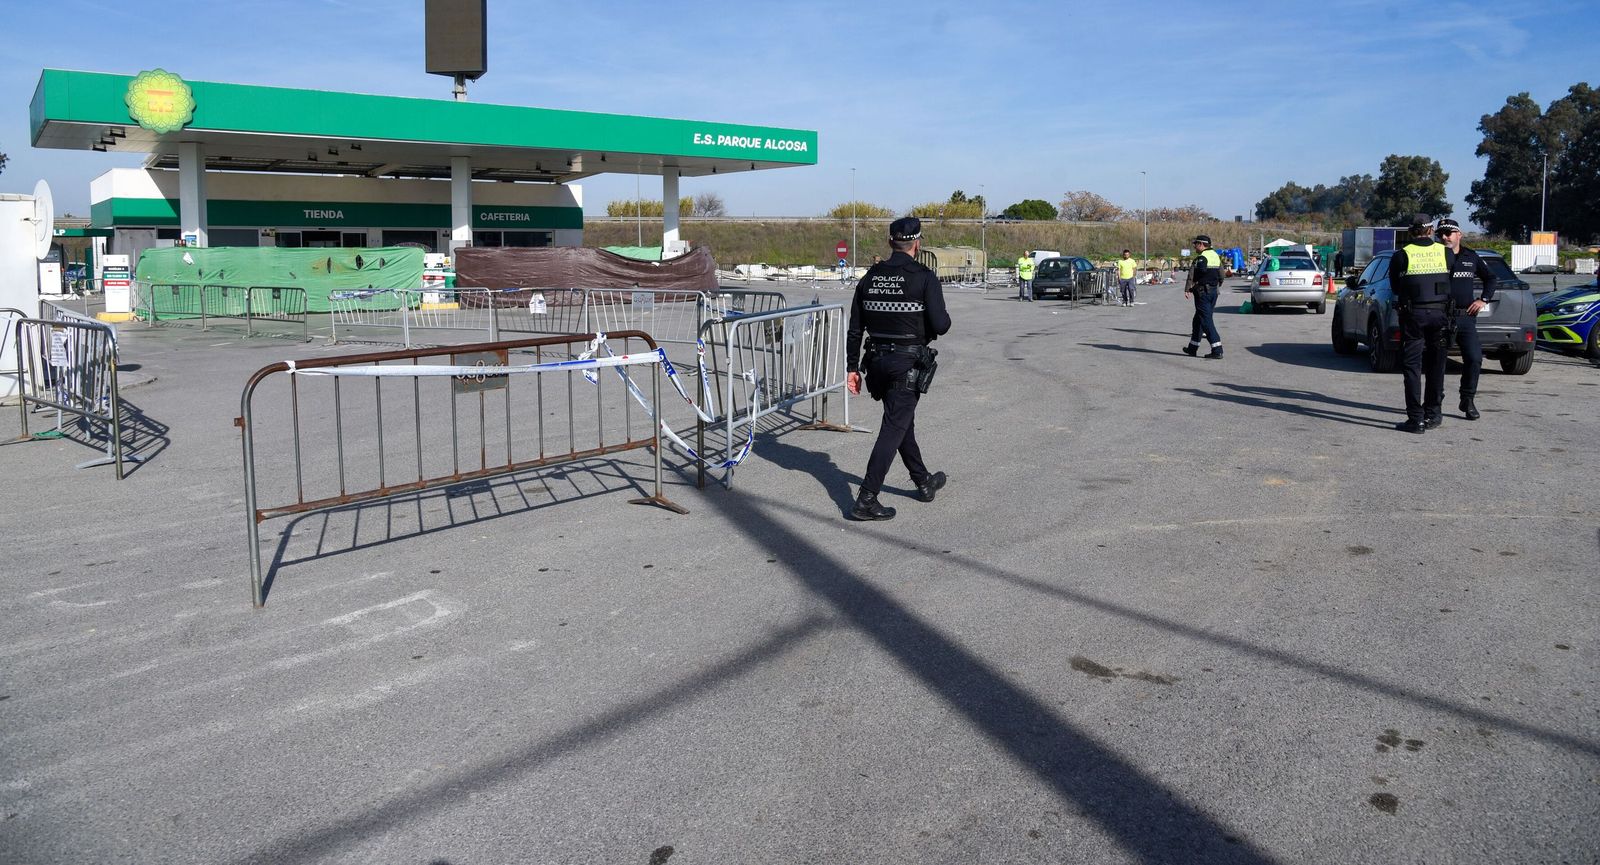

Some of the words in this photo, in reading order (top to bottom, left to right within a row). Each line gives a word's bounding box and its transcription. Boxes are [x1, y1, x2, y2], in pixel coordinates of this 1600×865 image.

[693, 133, 716, 145] E.S.
[717, 134, 762, 149] PARQUE
[764, 138, 808, 152] ALCOSA
[303, 209, 345, 219] TIENDA
[480, 212, 531, 221] CAFETERIA
